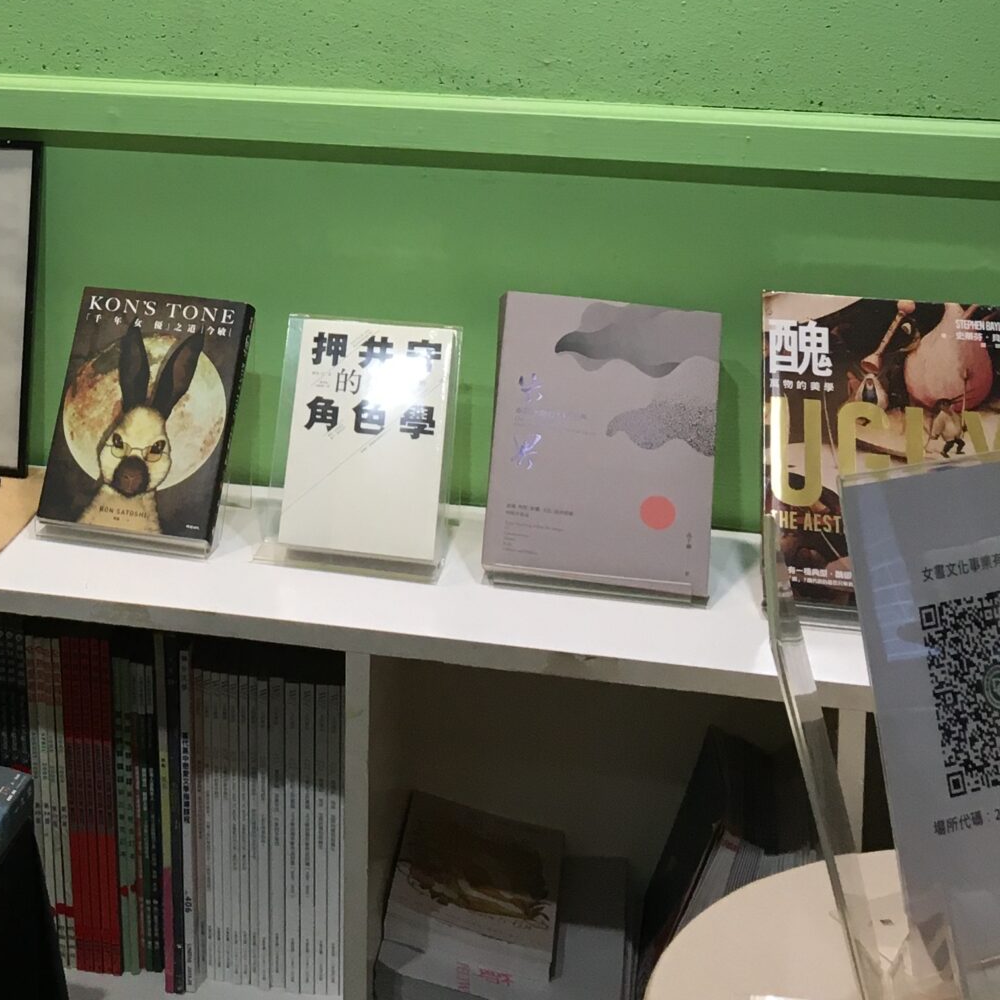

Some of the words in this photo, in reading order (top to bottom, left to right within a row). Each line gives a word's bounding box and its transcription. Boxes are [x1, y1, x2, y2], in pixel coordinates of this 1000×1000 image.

[89, 296, 157, 317] KON'S
[166, 303, 236, 326] TONE
[955, 319, 985, 331] STEPHEN
[985, 321, 1000, 332] BAY
[769, 319, 834, 377] 醜
[335, 368, 362, 395] 的
[304, 396, 436, 440] 角色學
